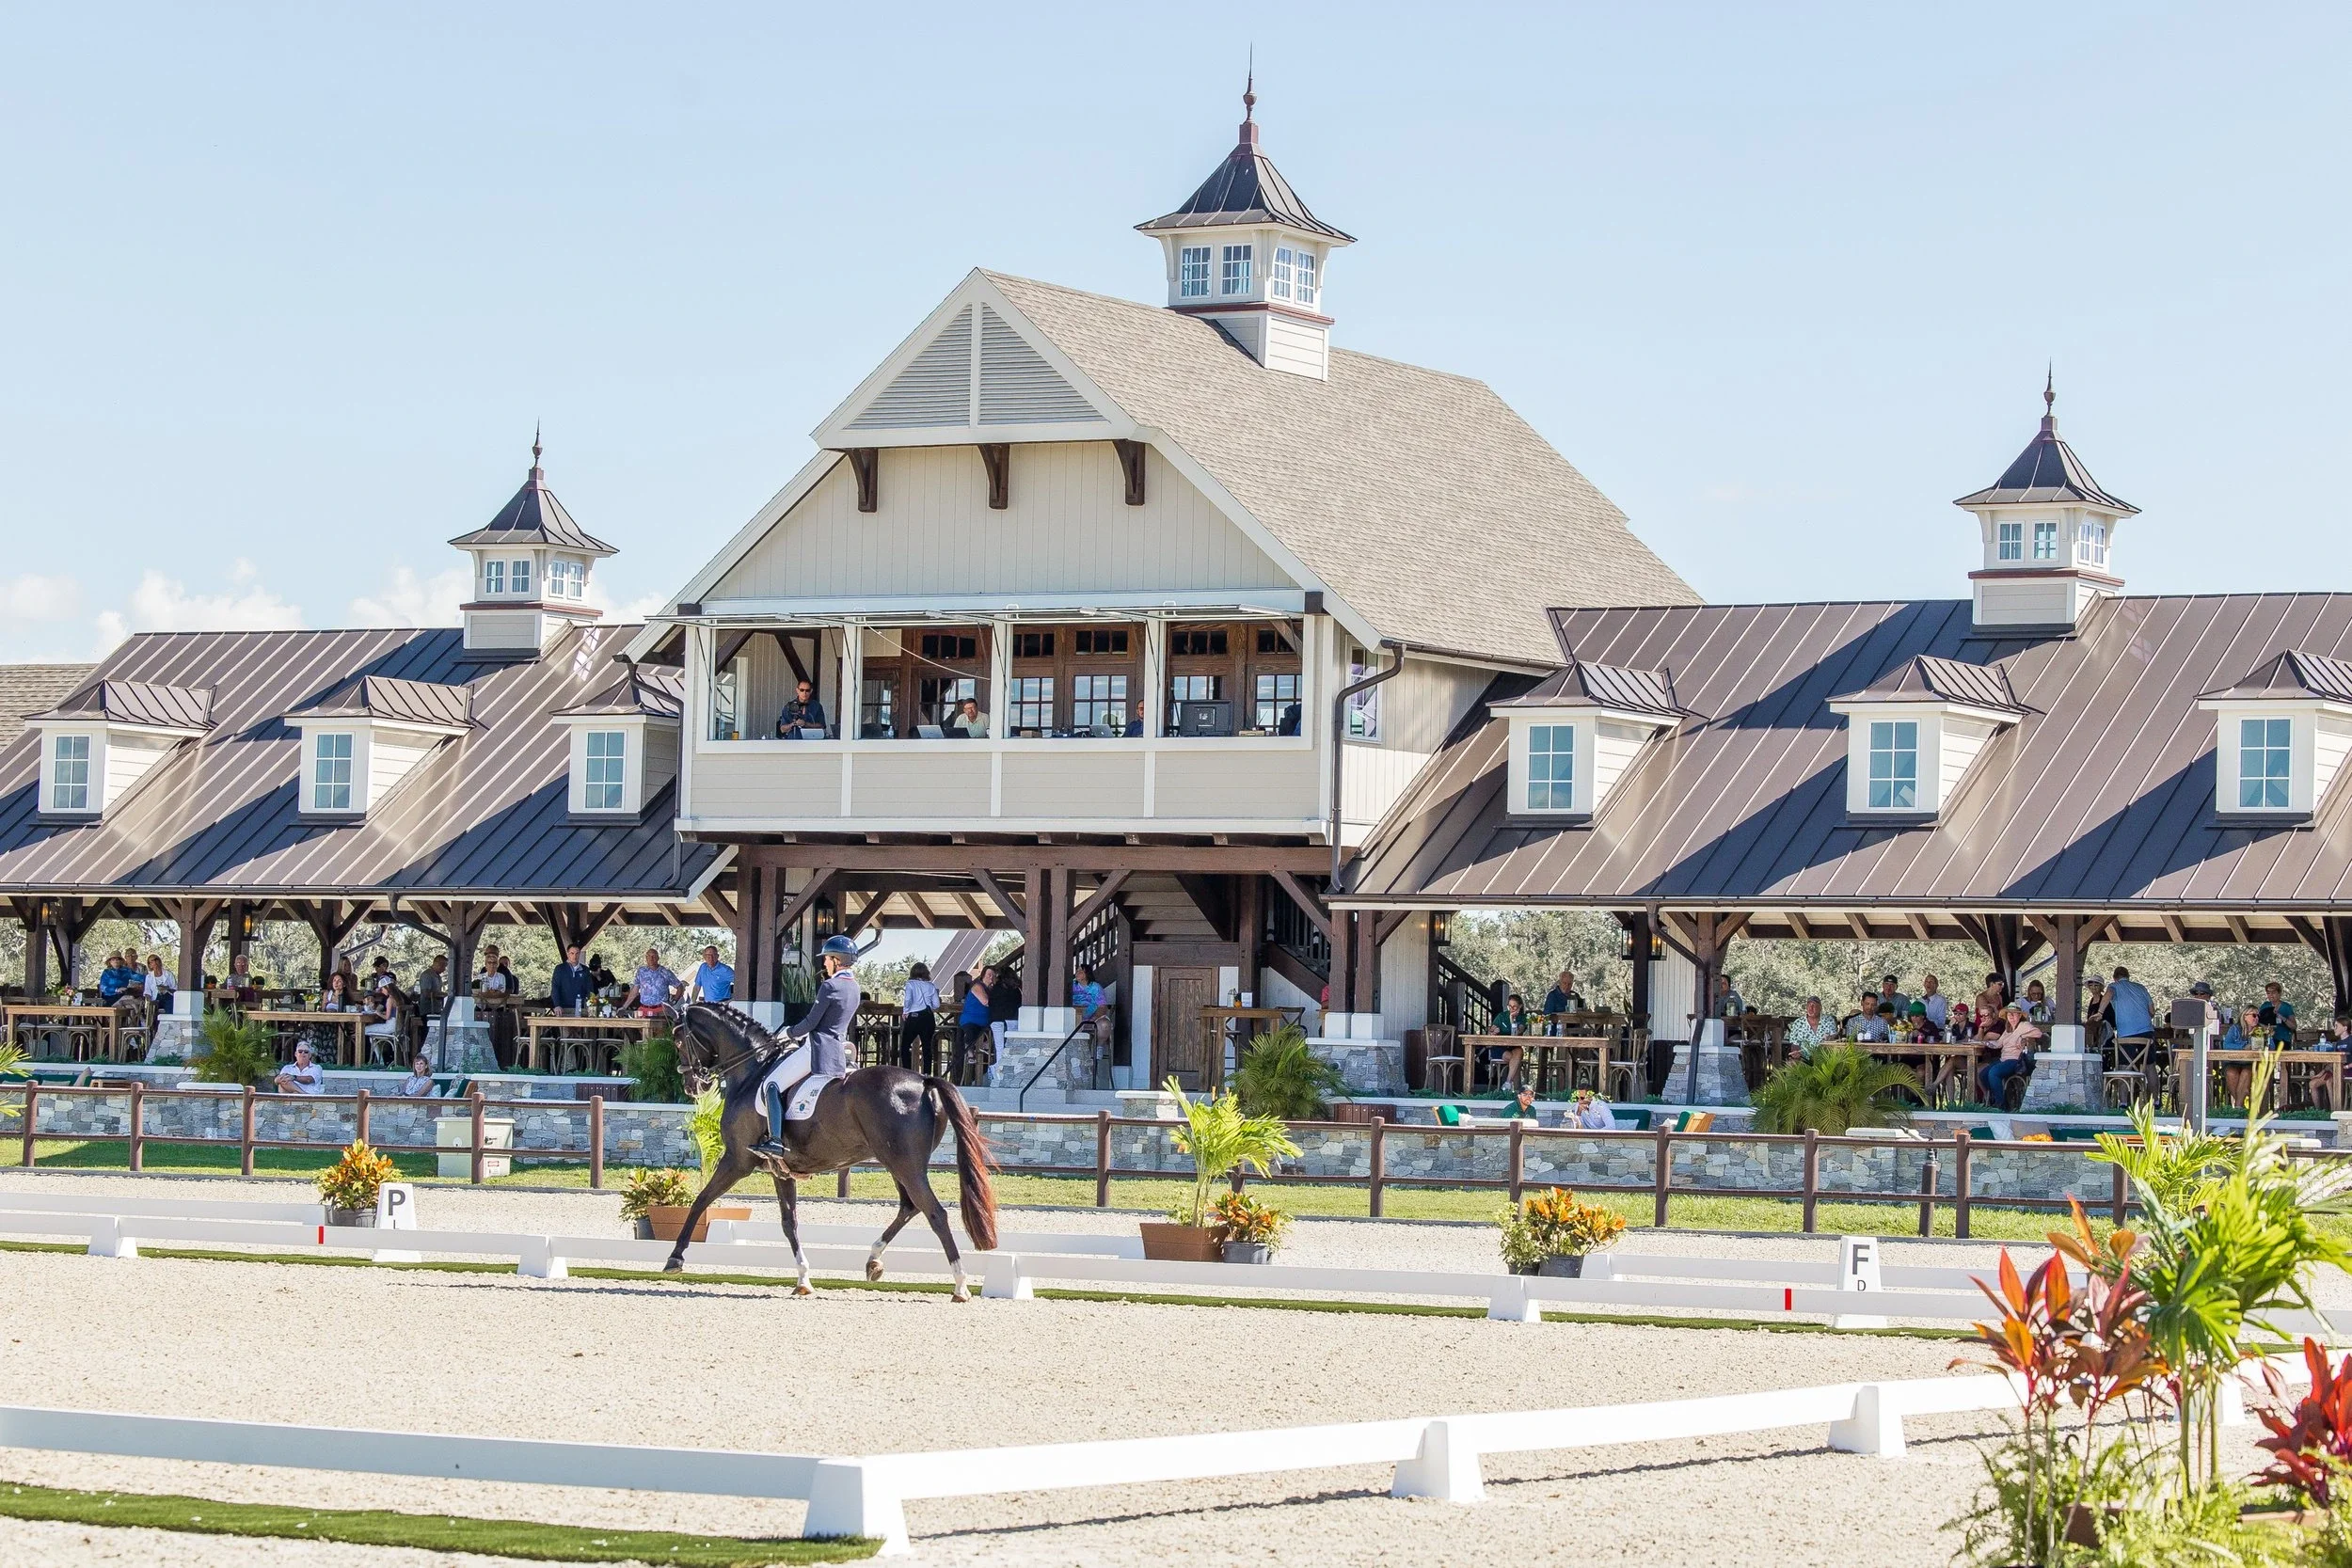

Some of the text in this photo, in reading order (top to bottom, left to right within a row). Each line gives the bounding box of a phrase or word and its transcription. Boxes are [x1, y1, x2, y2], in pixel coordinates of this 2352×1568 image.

[388, 1189, 406, 1216] P
[1851, 1243, 1870, 1275] F
[1857, 1279, 1867, 1291] D
